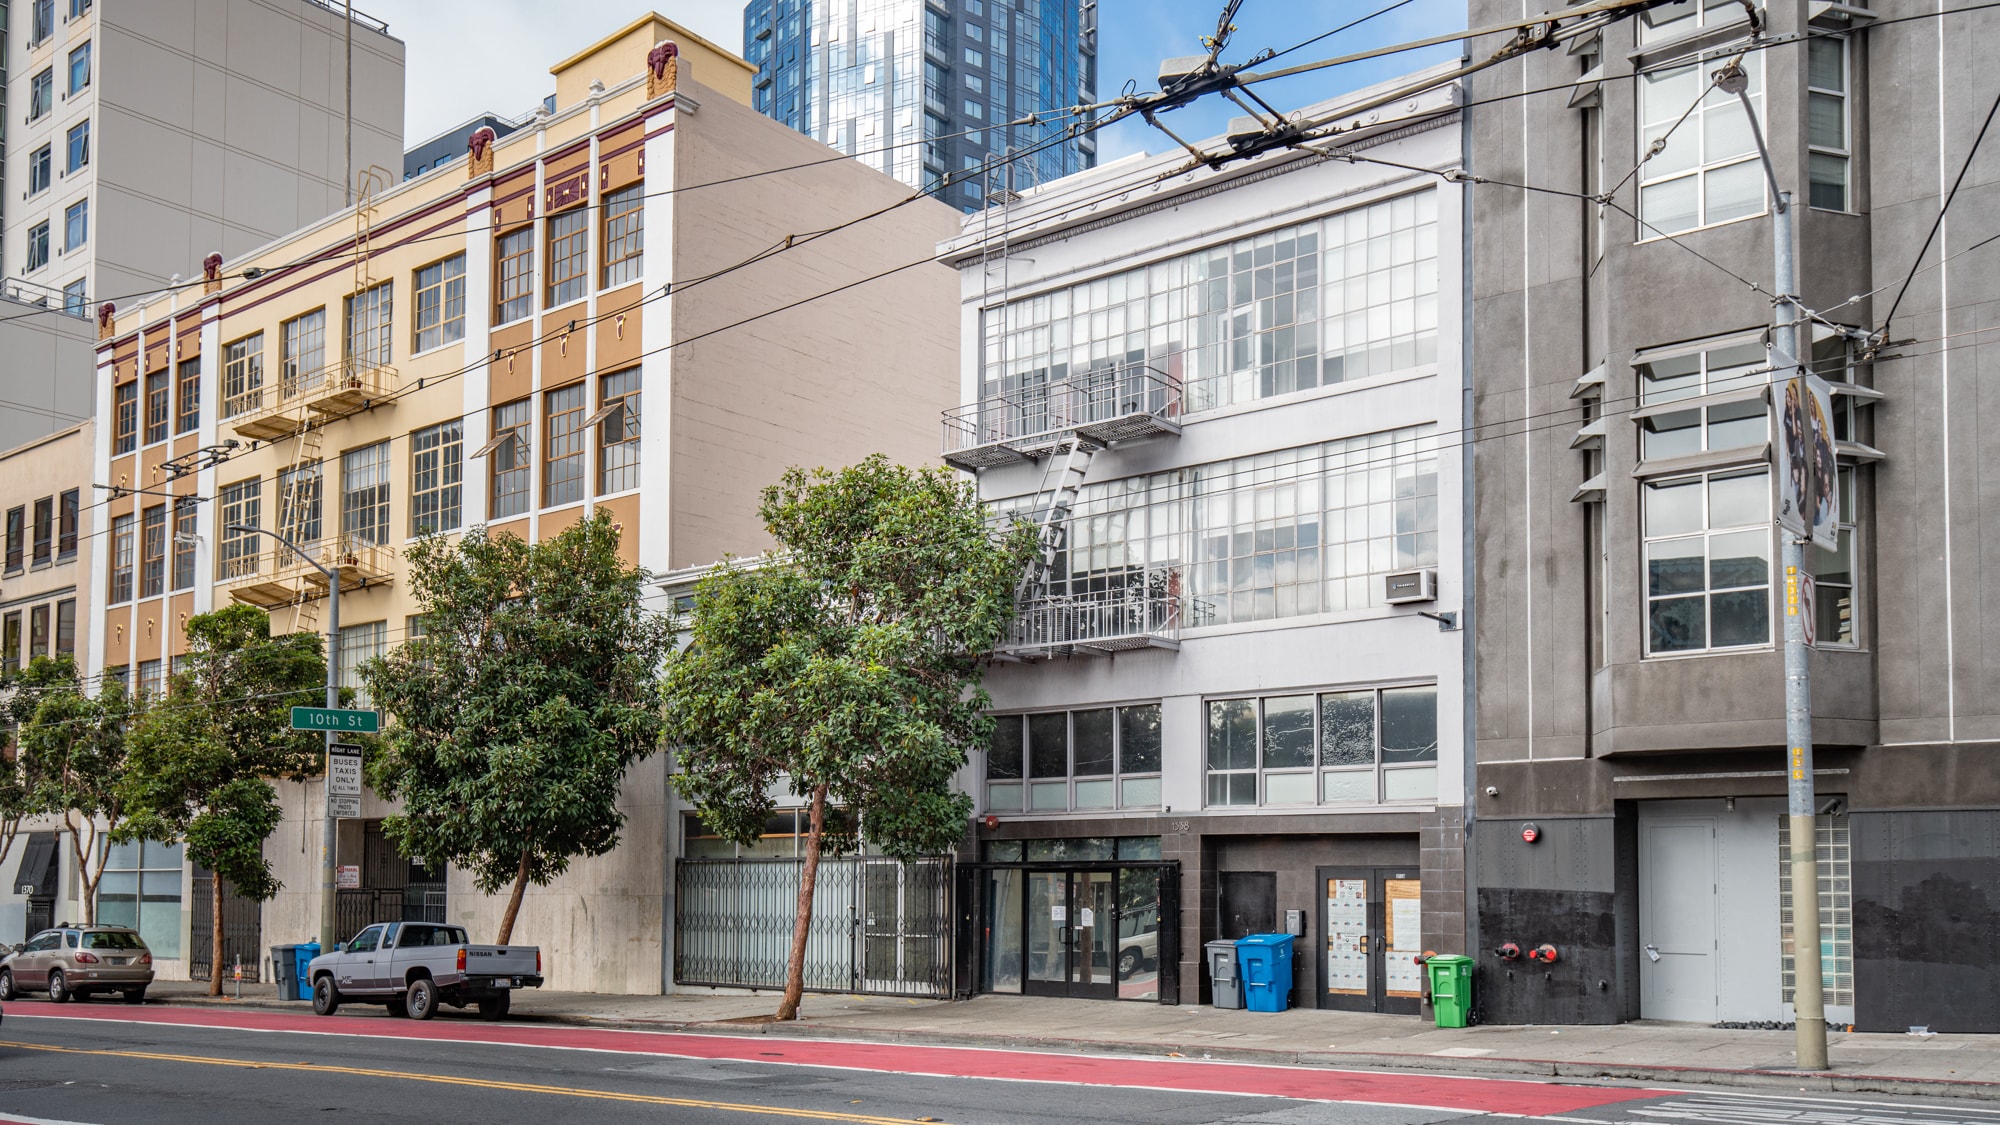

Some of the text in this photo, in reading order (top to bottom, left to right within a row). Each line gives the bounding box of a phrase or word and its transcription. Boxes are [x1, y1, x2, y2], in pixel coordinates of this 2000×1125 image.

[309, 713, 362, 727] 10th St
[333, 758, 358, 766] BUSES
[335, 767, 357, 775] TAXIS
[336, 776, 355, 784] ONLY
[21, 885, 34, 895] 1370
